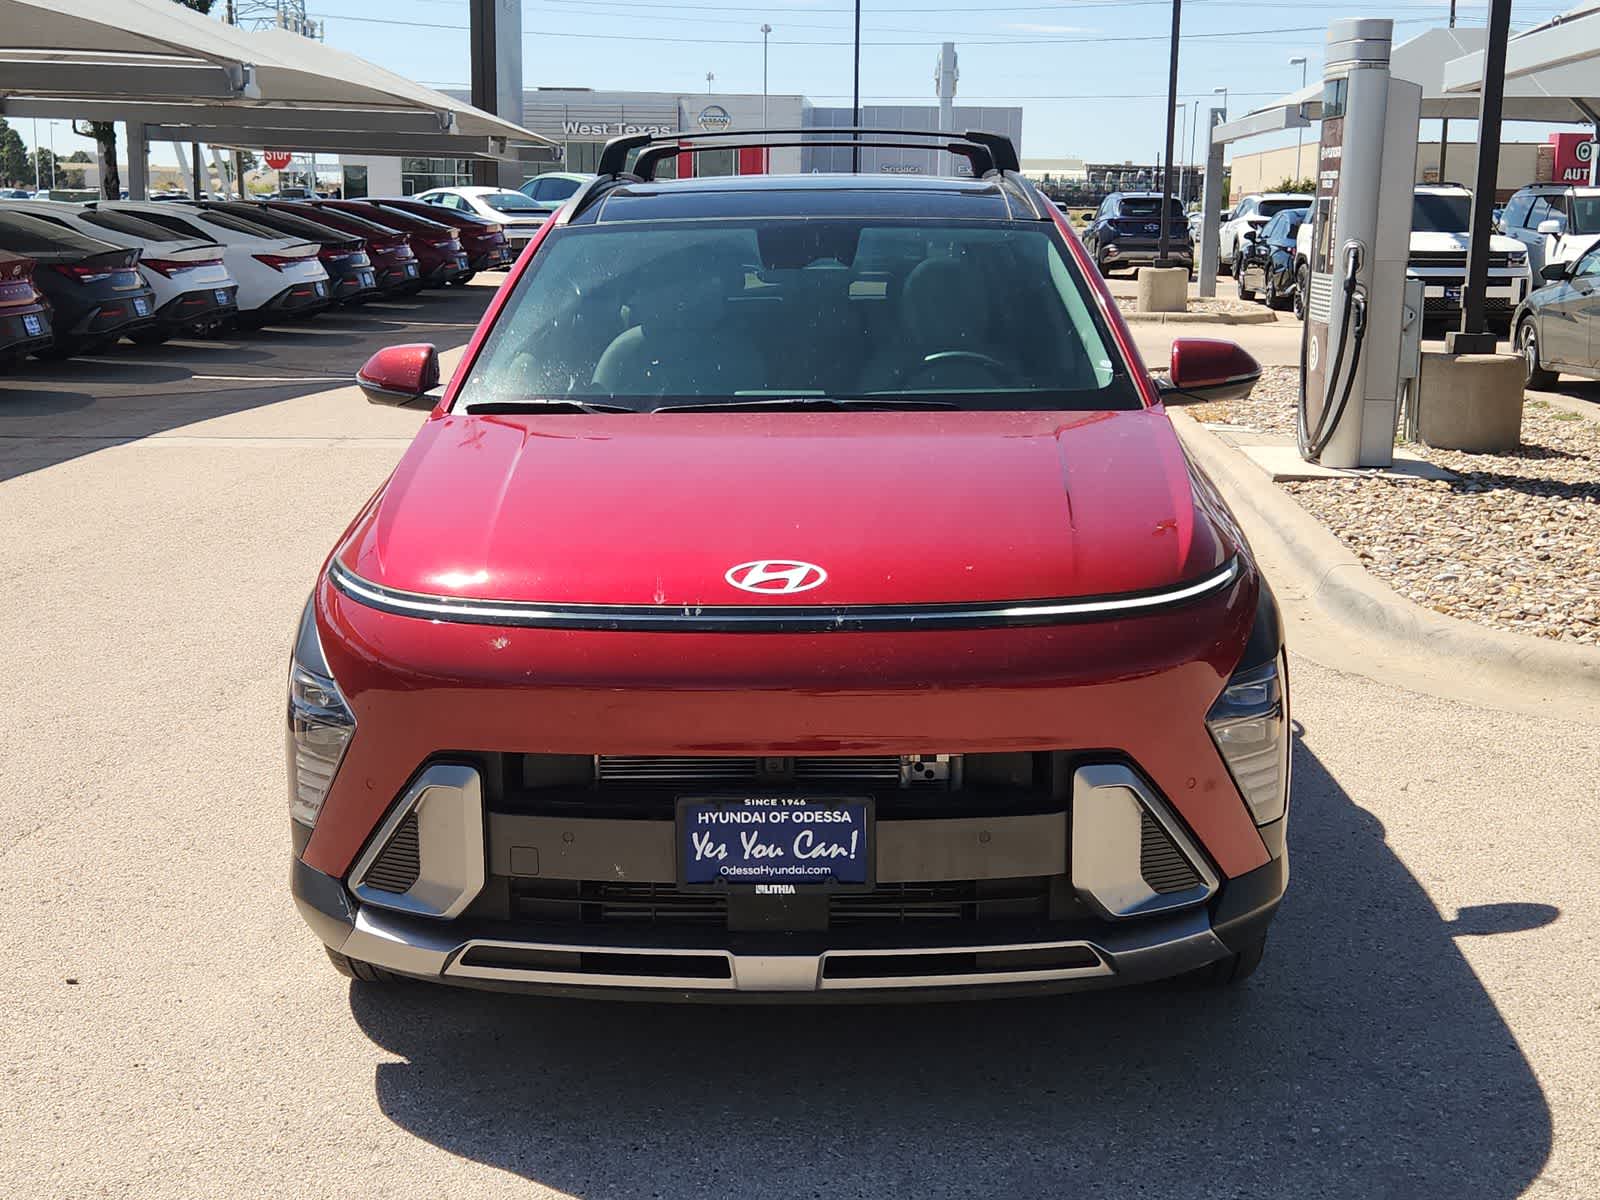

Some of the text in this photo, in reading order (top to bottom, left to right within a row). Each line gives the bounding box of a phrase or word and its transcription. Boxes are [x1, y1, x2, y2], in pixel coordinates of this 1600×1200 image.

[700, 116, 729, 125] NISSAN
[562, 121, 671, 136] West Texas
[265, 150, 290, 161] STOP
[744, 798, 807, 806] SINCE 1946
[698, 811, 853, 824] HYUNDAI OF ODESSA
[692, 829, 859, 861] Yes You Can!
[719, 865, 832, 877] OdessaHyundai.com
